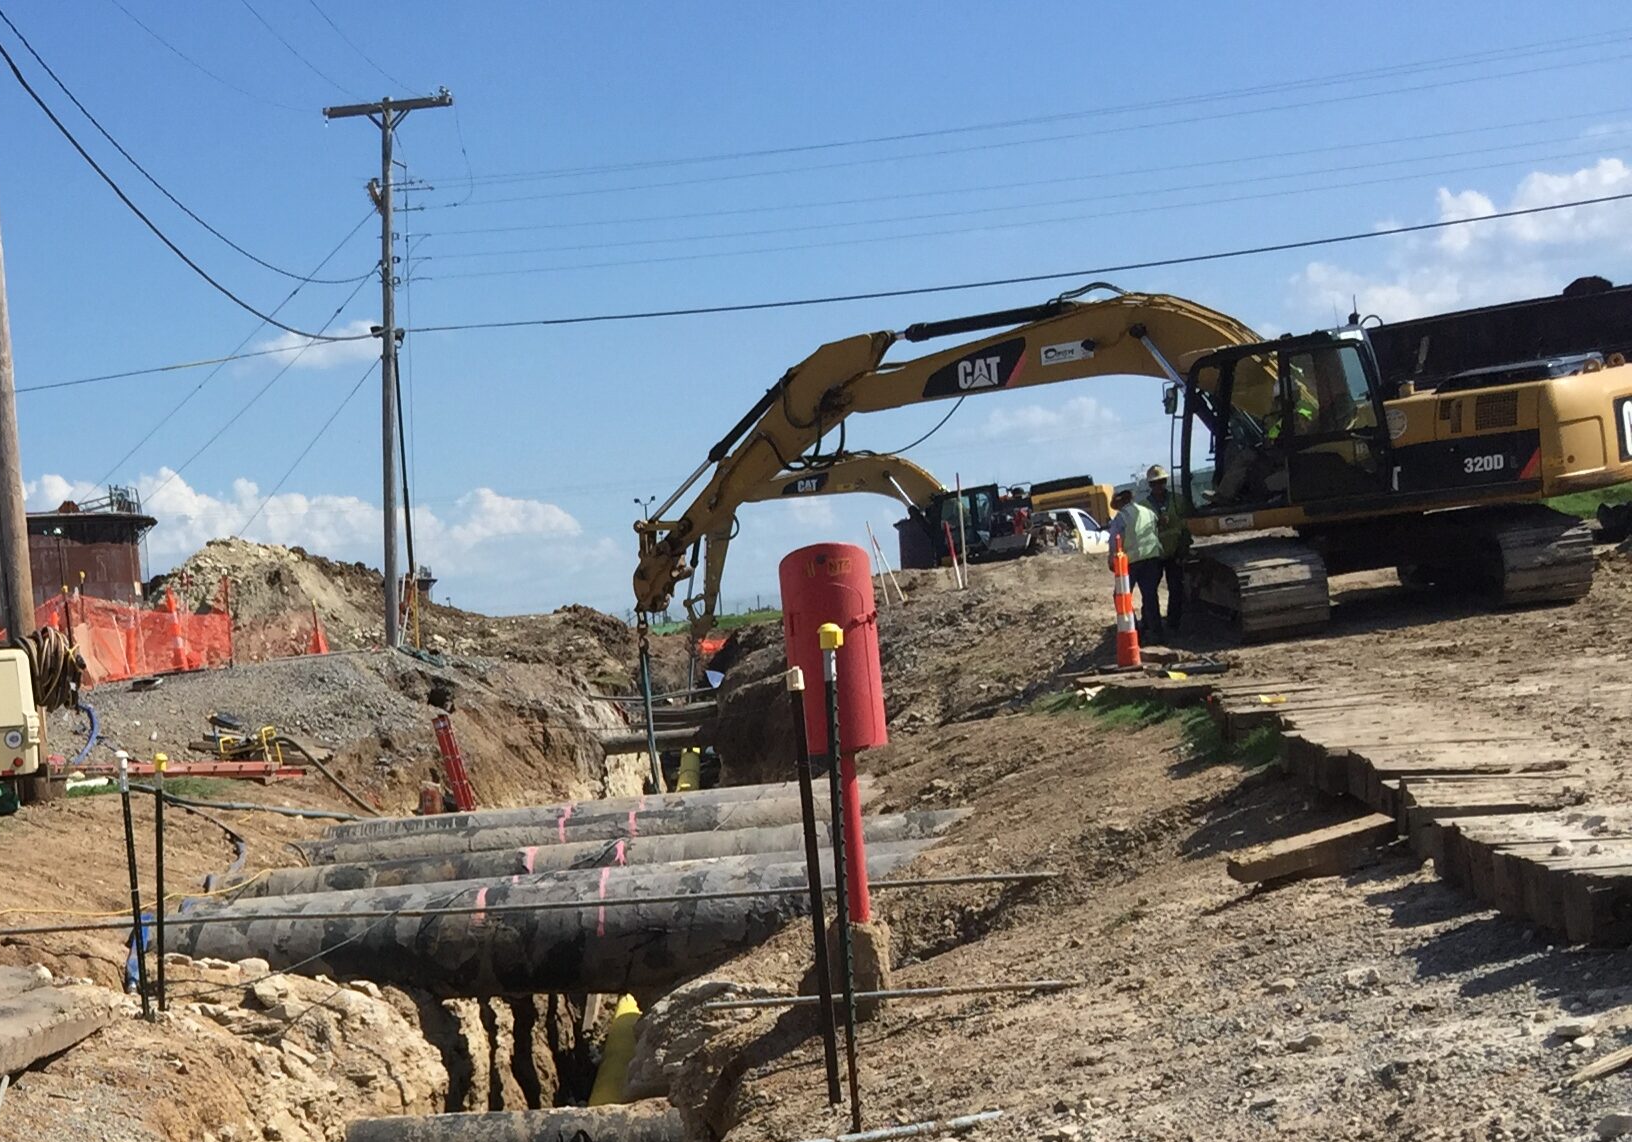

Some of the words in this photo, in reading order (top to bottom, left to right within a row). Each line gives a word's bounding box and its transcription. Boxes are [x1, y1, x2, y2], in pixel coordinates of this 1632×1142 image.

[957, 356, 1001, 390] CAT
[1463, 453, 1504, 474] 320D
[797, 479, 817, 493] CAT
